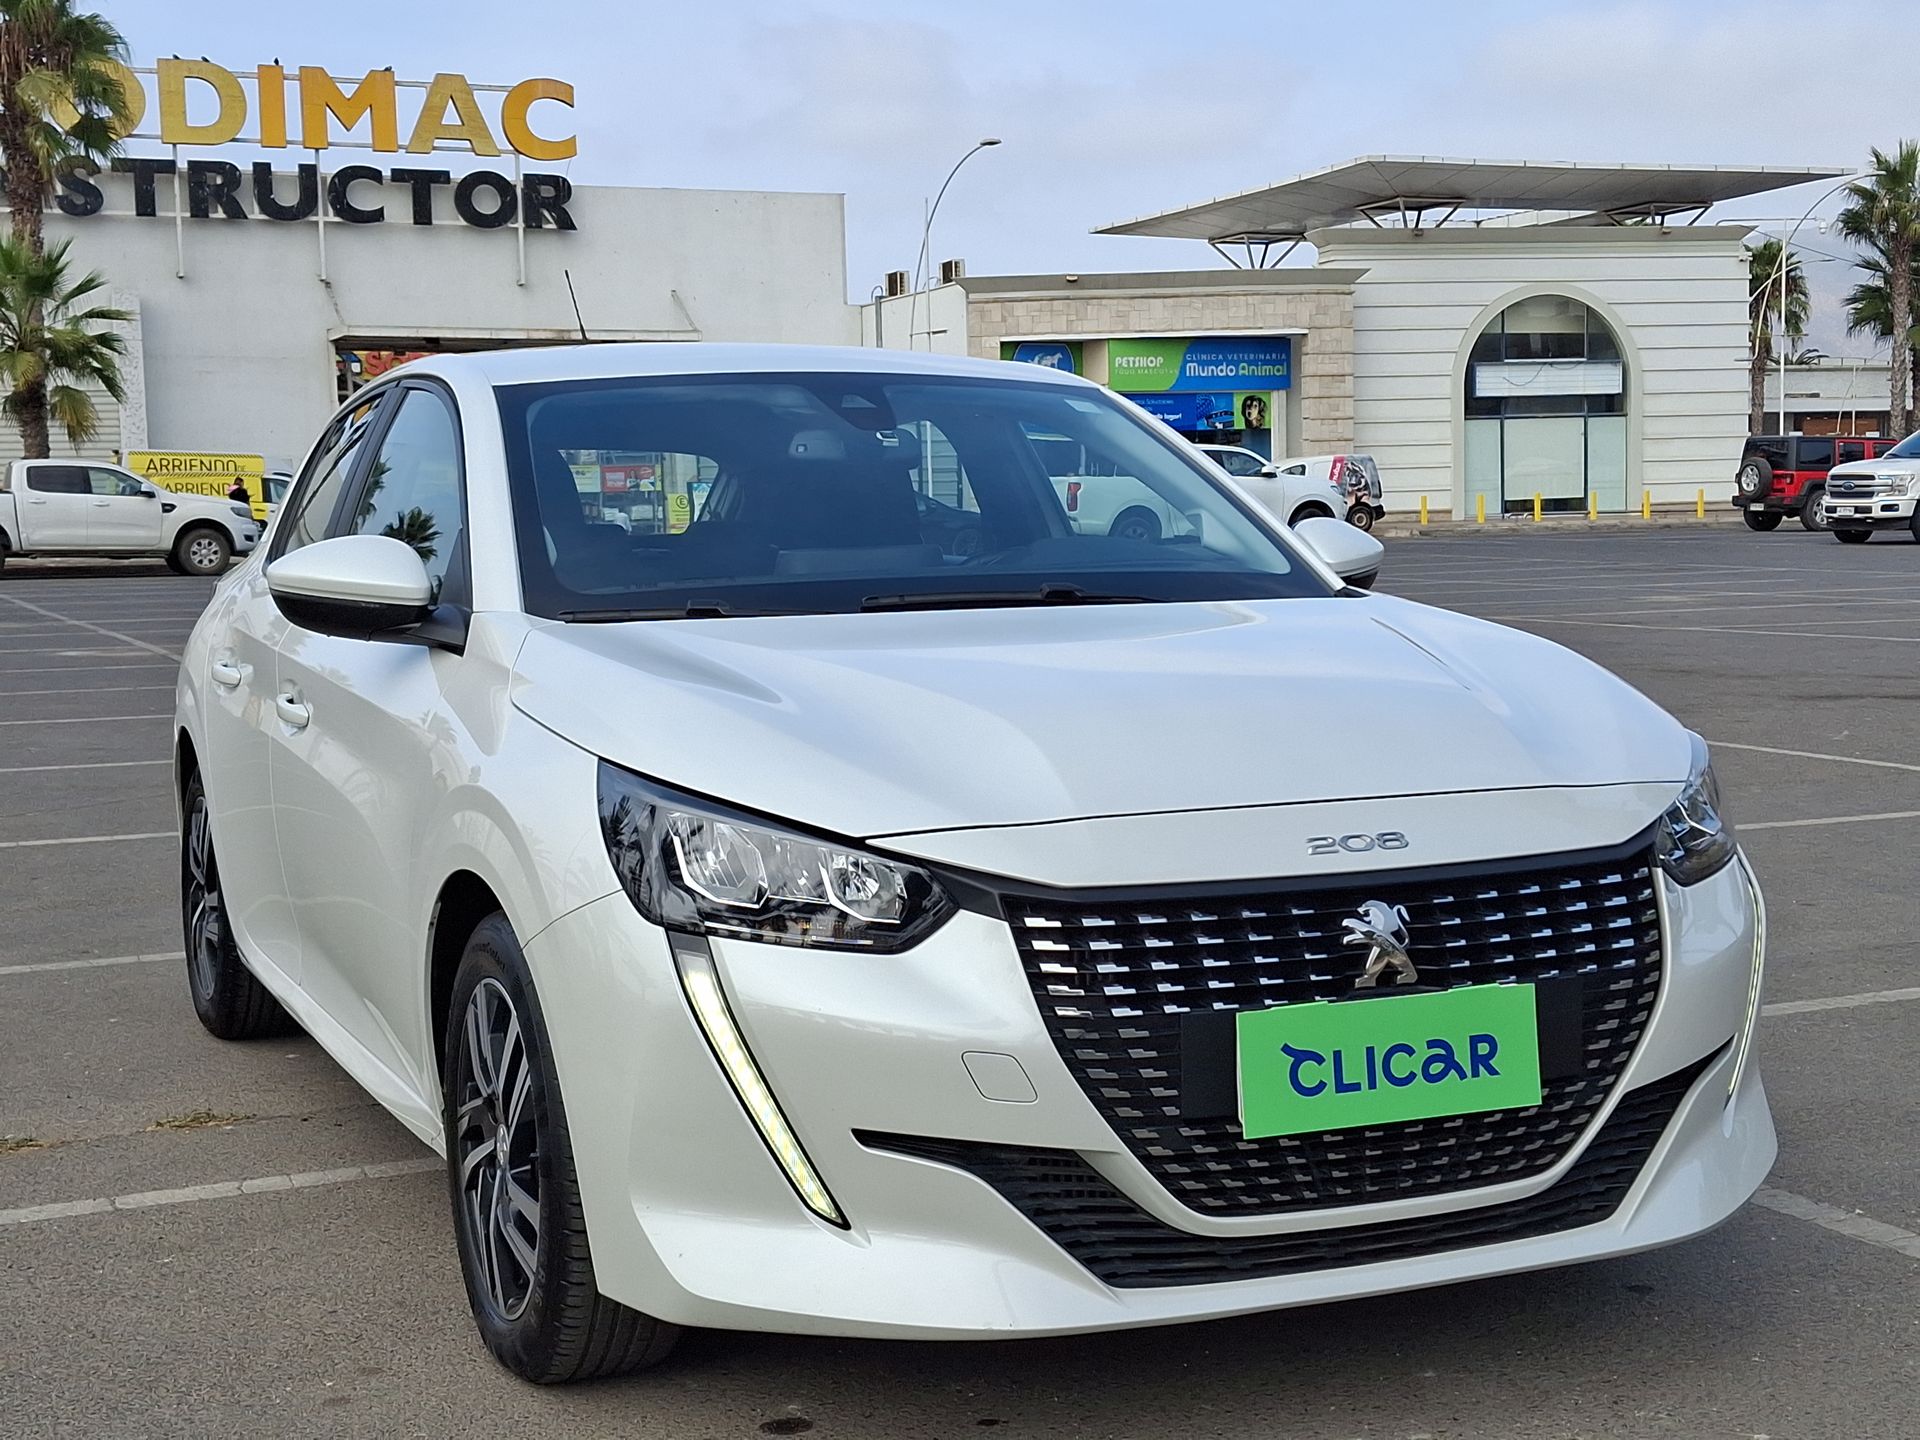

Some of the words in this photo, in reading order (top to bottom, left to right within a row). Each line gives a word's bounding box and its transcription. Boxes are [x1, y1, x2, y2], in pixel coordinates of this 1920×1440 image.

[0, 155, 578, 231] STRUCTOR
[1115, 356, 1164, 368] PETSHOP
[1227, 353, 1287, 361] VETERINARIA
[1186, 362, 1236, 377] Mundo
[1238, 361, 1287, 377] Animal
[165, 482, 231, 497] ARRIEND
[1306, 832, 1410, 856] 208
